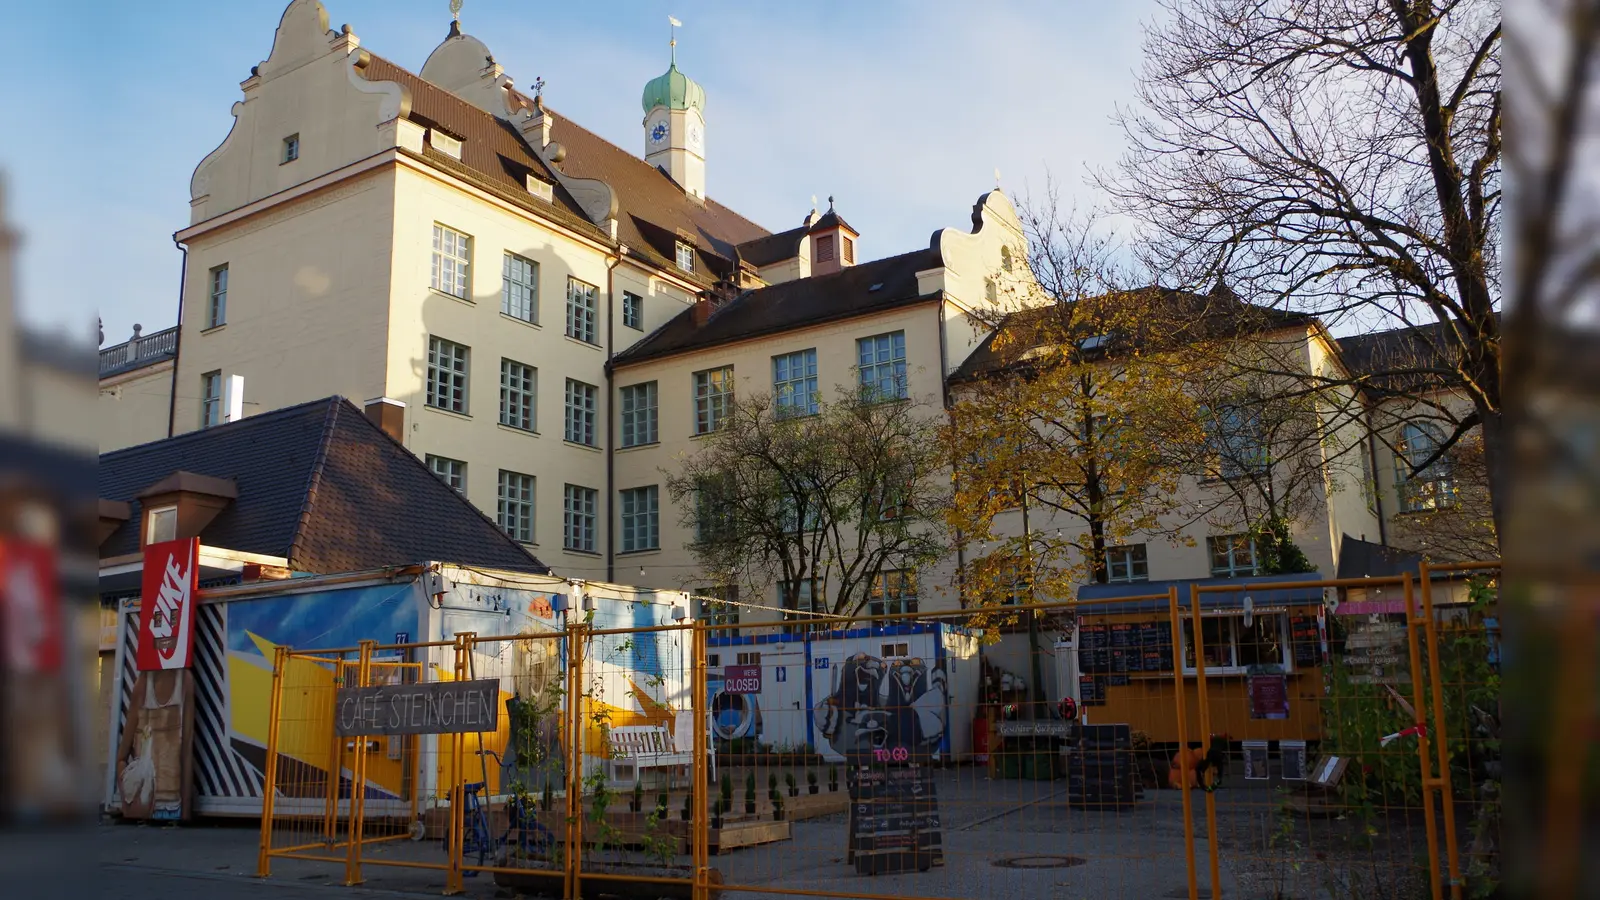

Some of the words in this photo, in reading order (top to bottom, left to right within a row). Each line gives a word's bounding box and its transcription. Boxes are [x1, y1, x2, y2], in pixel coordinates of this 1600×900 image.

[396, 634, 407, 644] 77
[726, 678, 759, 692] CLOSED
[341, 690, 384, 730] CAFÉ
[389, 689, 494, 728] STEINCHEN
[873, 749, 891, 761] TO
[892, 746, 909, 761] GO
